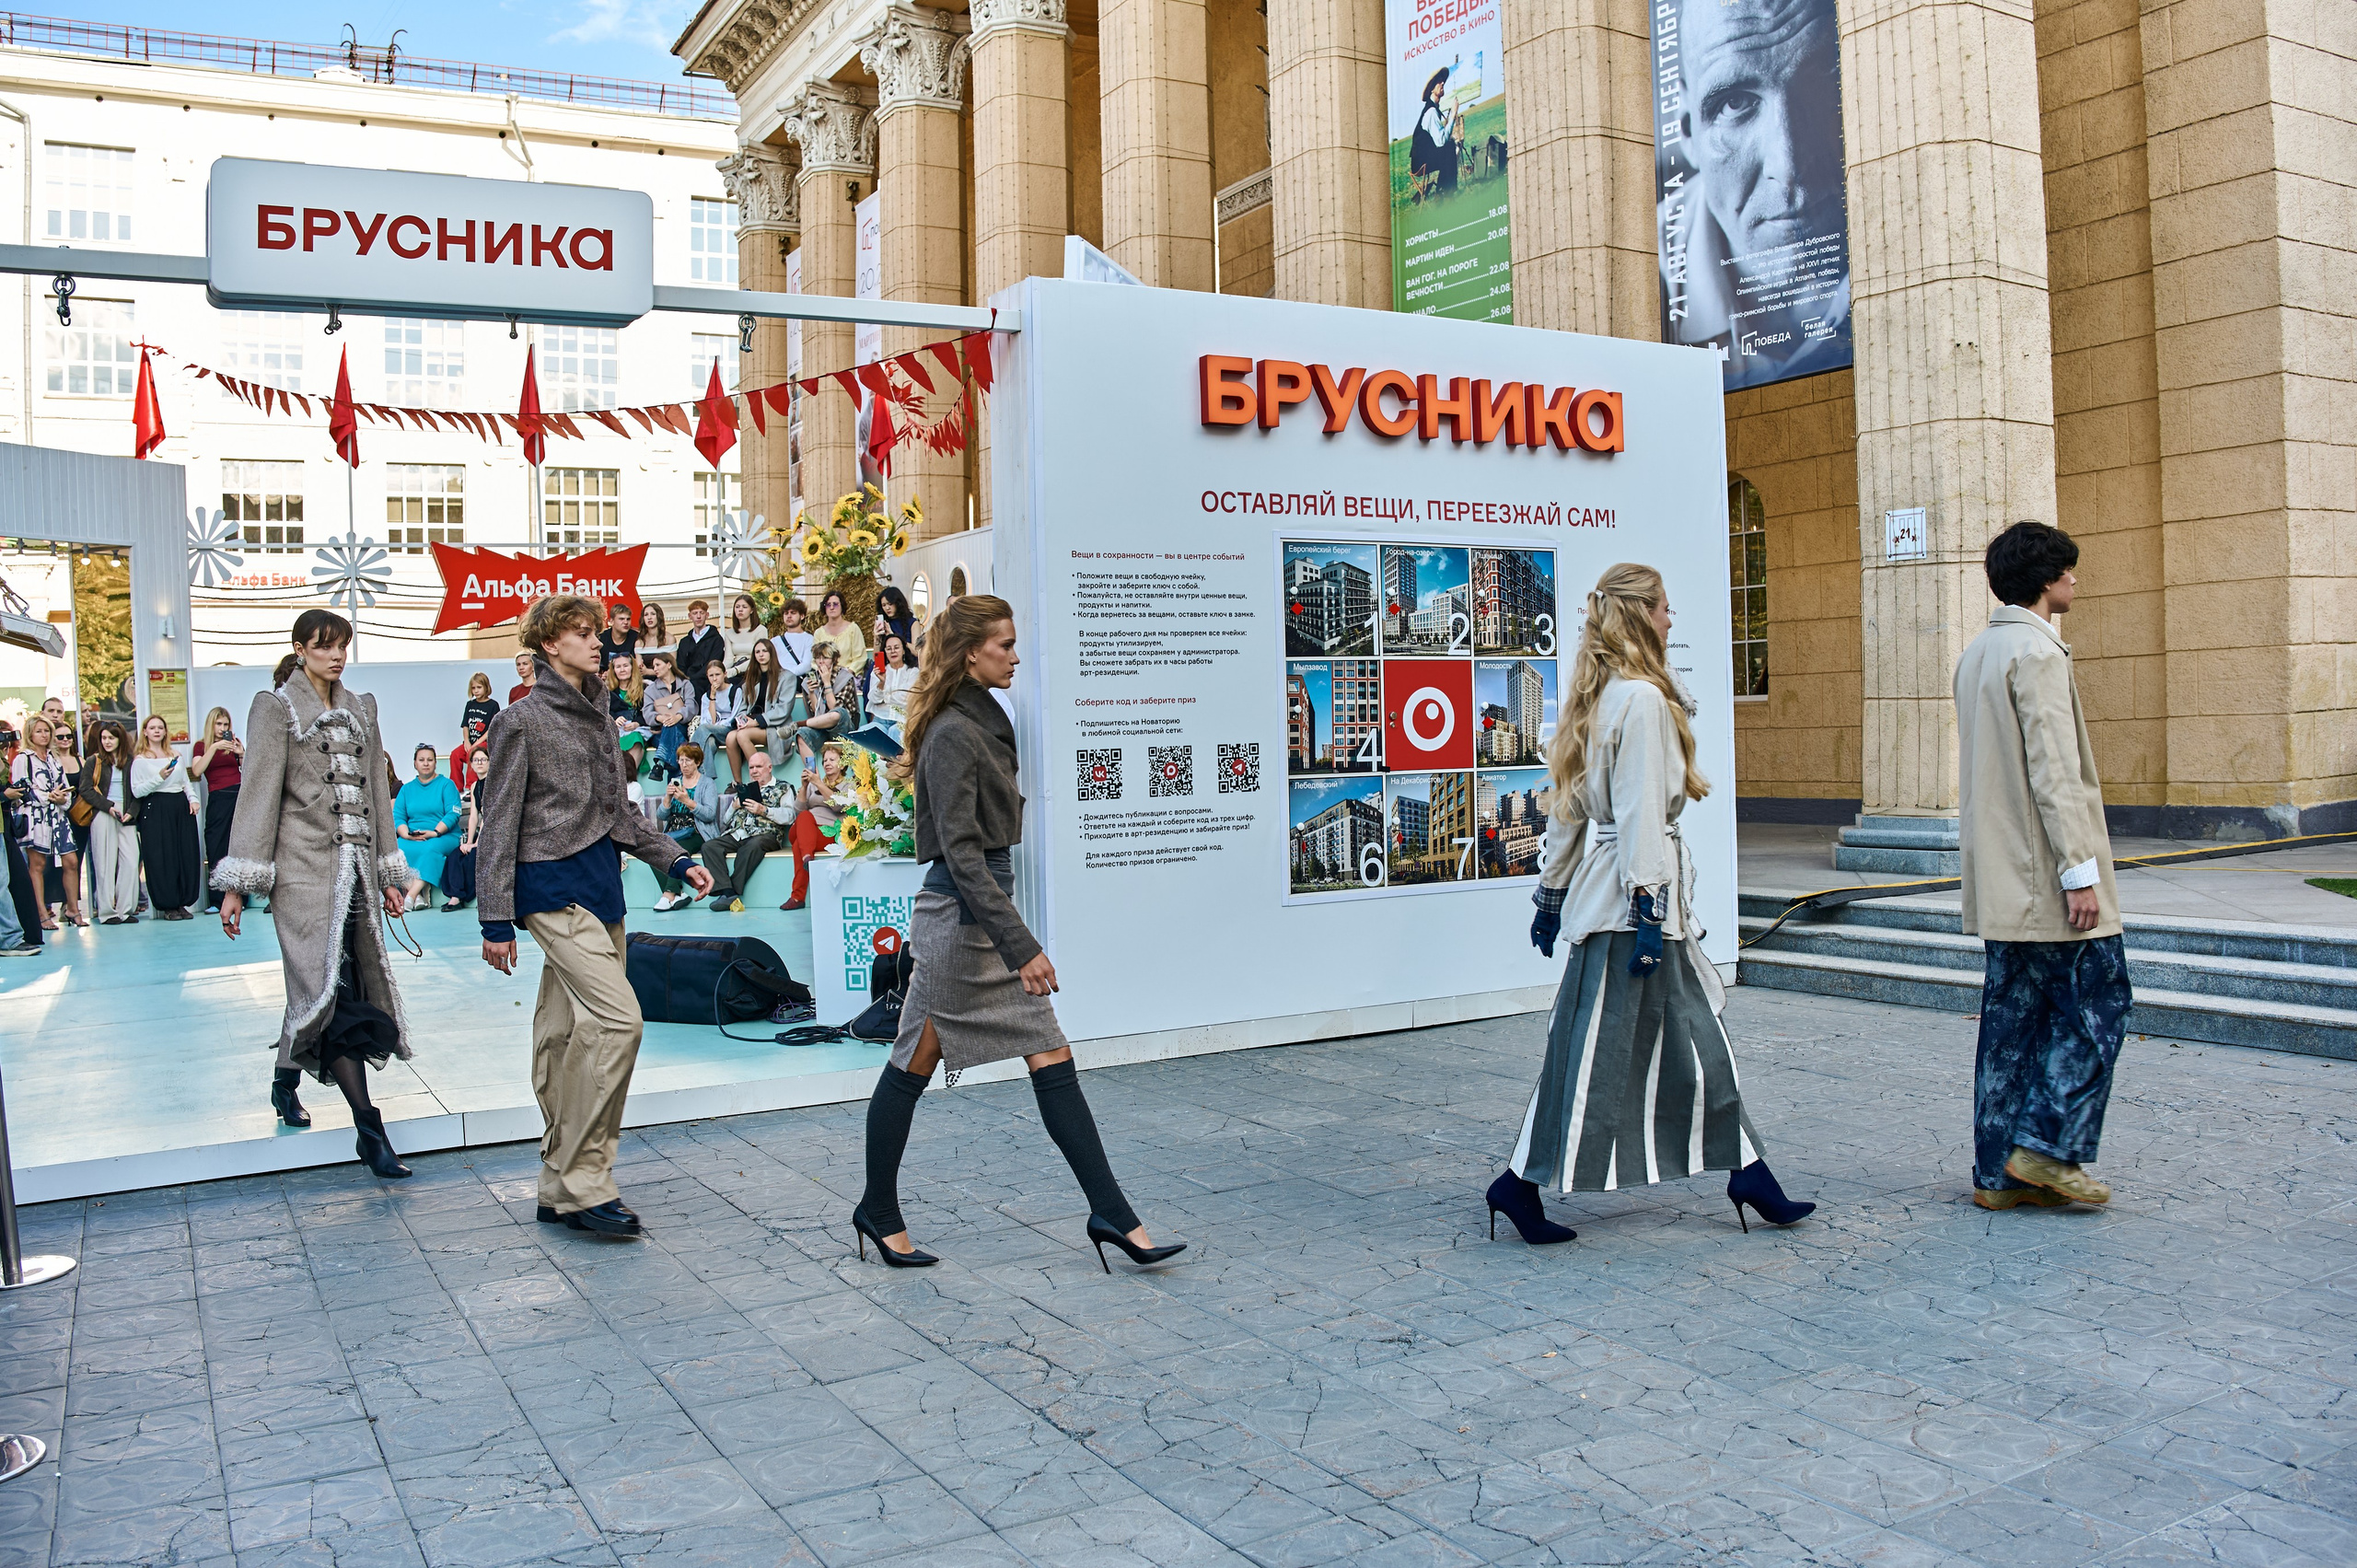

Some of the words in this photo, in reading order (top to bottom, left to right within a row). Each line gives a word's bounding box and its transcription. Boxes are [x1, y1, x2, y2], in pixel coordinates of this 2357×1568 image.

[1404, 29, 1457, 61] ИСКУССТВО
[1460, 24, 1466, 35] В
[1469, 10, 1494, 30] КИНО
[1663, 120, 1682, 147] 19
[1665, 171, 1688, 284] АВГУСТА
[1720, 256, 1744, 266] Выставка
[1746, 250, 1773, 261] фотографа
[1774, 241, 1804, 252] Владимира
[1805, 232, 1840, 246] Дубровского
[1768, 257, 1790, 266] история
[1791, 248, 1817, 259] непростой
[1819, 244, 1840, 254] победы
[1405, 251, 1434, 268] МАРТИН
[1406, 278, 1420, 288] ВАН
[1422, 272, 1435, 284] ГОГ.
[1437, 268, 1447, 278] НА
[1449, 258, 1479, 274] ПОРОГЕ
[1490, 261, 1509, 275] 22.08
[1739, 272, 1771, 284] Александра
[1806, 261, 1819, 269] XXVI
[1821, 256, 1840, 265] летних
[1490, 284, 1510, 296] 24.08
[1736, 284, 1771, 296] Олимпийских
[1759, 292, 1781, 302] навсегда
[1782, 286, 1809, 297] вошедшей
[1816, 279, 1839, 289] историю
[1490, 305, 1511, 319] 26.08
[1669, 295, 1689, 322] 21
[1728, 306, 1767, 320] греко-римской
[1768, 302, 1786, 312] борьбы
[1794, 296, 1818, 307] мирового
[1805, 321, 1826, 331] белая
[1805, 326, 1833, 339] галерея
[1755, 331, 1791, 347] ПОБЕДА
[1201, 489, 1336, 517] ОСТАВЛЯЙ
[1344, 497, 1420, 524] ВЕЩИ,
[1426, 500, 1562, 527] ПЕРЕЕЗЖАЙ
[1567, 507, 1616, 528] САМ!
[1072, 551, 1094, 559] Вещи
[1289, 545, 1330, 553] Европейский
[1333, 546, 1352, 554] берег
[272, 573, 307, 587] Банк
[461, 573, 552, 605] Альфа
[557, 573, 623, 597] Банк
[1077, 592, 1122, 600] Пожалуйста,
[1078, 602, 1113, 610] продукты
[1364, 611, 1379, 656] 1
[1447, 613, 1470, 656] 2
[1534, 613, 1556, 656] 3
[1293, 662, 1329, 672] Мылзавод
[1480, 662, 1512, 670] Молодость
[1075, 699, 1114, 707] Соберите
[1140, 697, 1176, 705] заберите
[1081, 720, 1130, 728] Подпишитесь
[1122, 727, 1164, 736] социальной
[1356, 728, 1382, 772] 4
[1401, 775, 1441, 785] Декабристов
[1481, 772, 1507, 782] Авиатор
[1294, 780, 1338, 790] Лебедевский
[1084, 813, 1123, 821] Дождитесь
[1125, 810, 1167, 819] публикации
[1175, 807, 1213, 816] вопросами.
[1128, 819, 1155, 829] каждый
[1164, 819, 1195, 827] соберите
[1085, 832, 1123, 842] Приходите
[1131, 828, 1188, 838] арт-резиденцию
[1196, 825, 1230, 833] забирайте
[1102, 850, 1132, 859] каждого
[1133, 849, 1154, 857] приза
[1155, 845, 1190, 855] действует
[1452, 837, 1474, 881] 7
[1086, 860, 1128, 868] Количество
[1130, 858, 1154, 866] призов
[1155, 855, 1197, 865] ограничено.
[1360, 842, 1383, 887] 6
